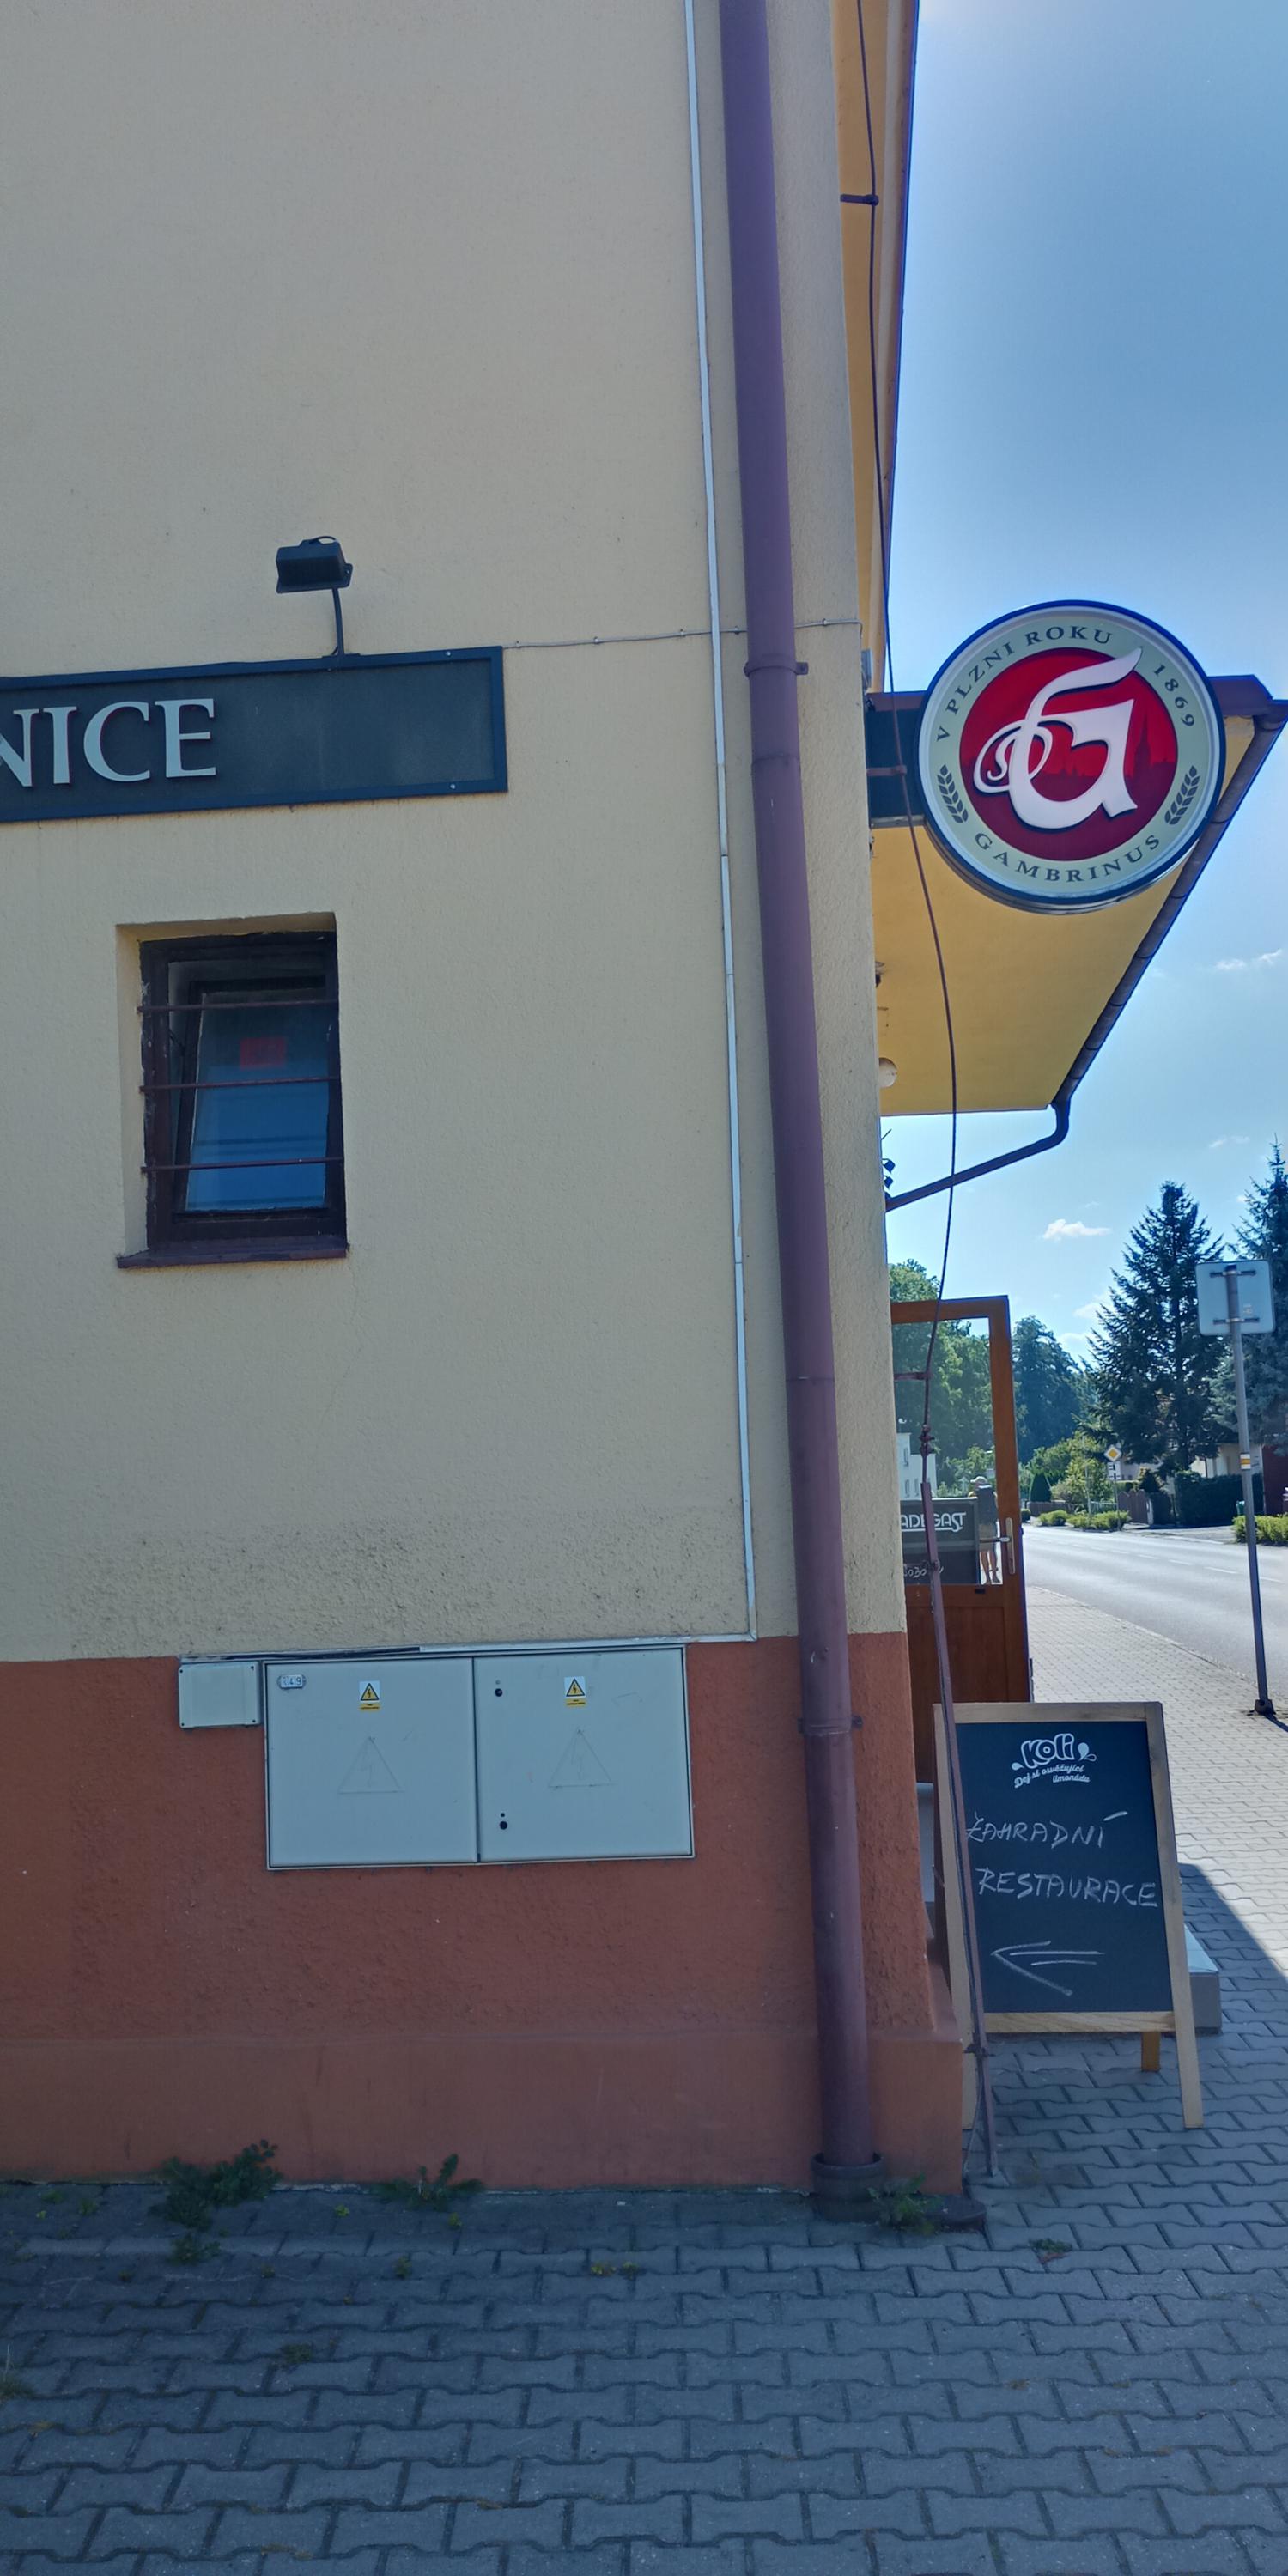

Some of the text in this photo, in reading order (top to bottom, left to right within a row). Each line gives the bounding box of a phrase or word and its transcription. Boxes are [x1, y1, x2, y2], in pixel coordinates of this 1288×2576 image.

[936, 625, 1195, 743] V PLZNI ROKU 1869
[975, 832, 1161, 883] GAMBRINUS
[1014, 1772, 1031, 1789] Dej
[975, 1867, 1157, 1907] RESTAURACE
